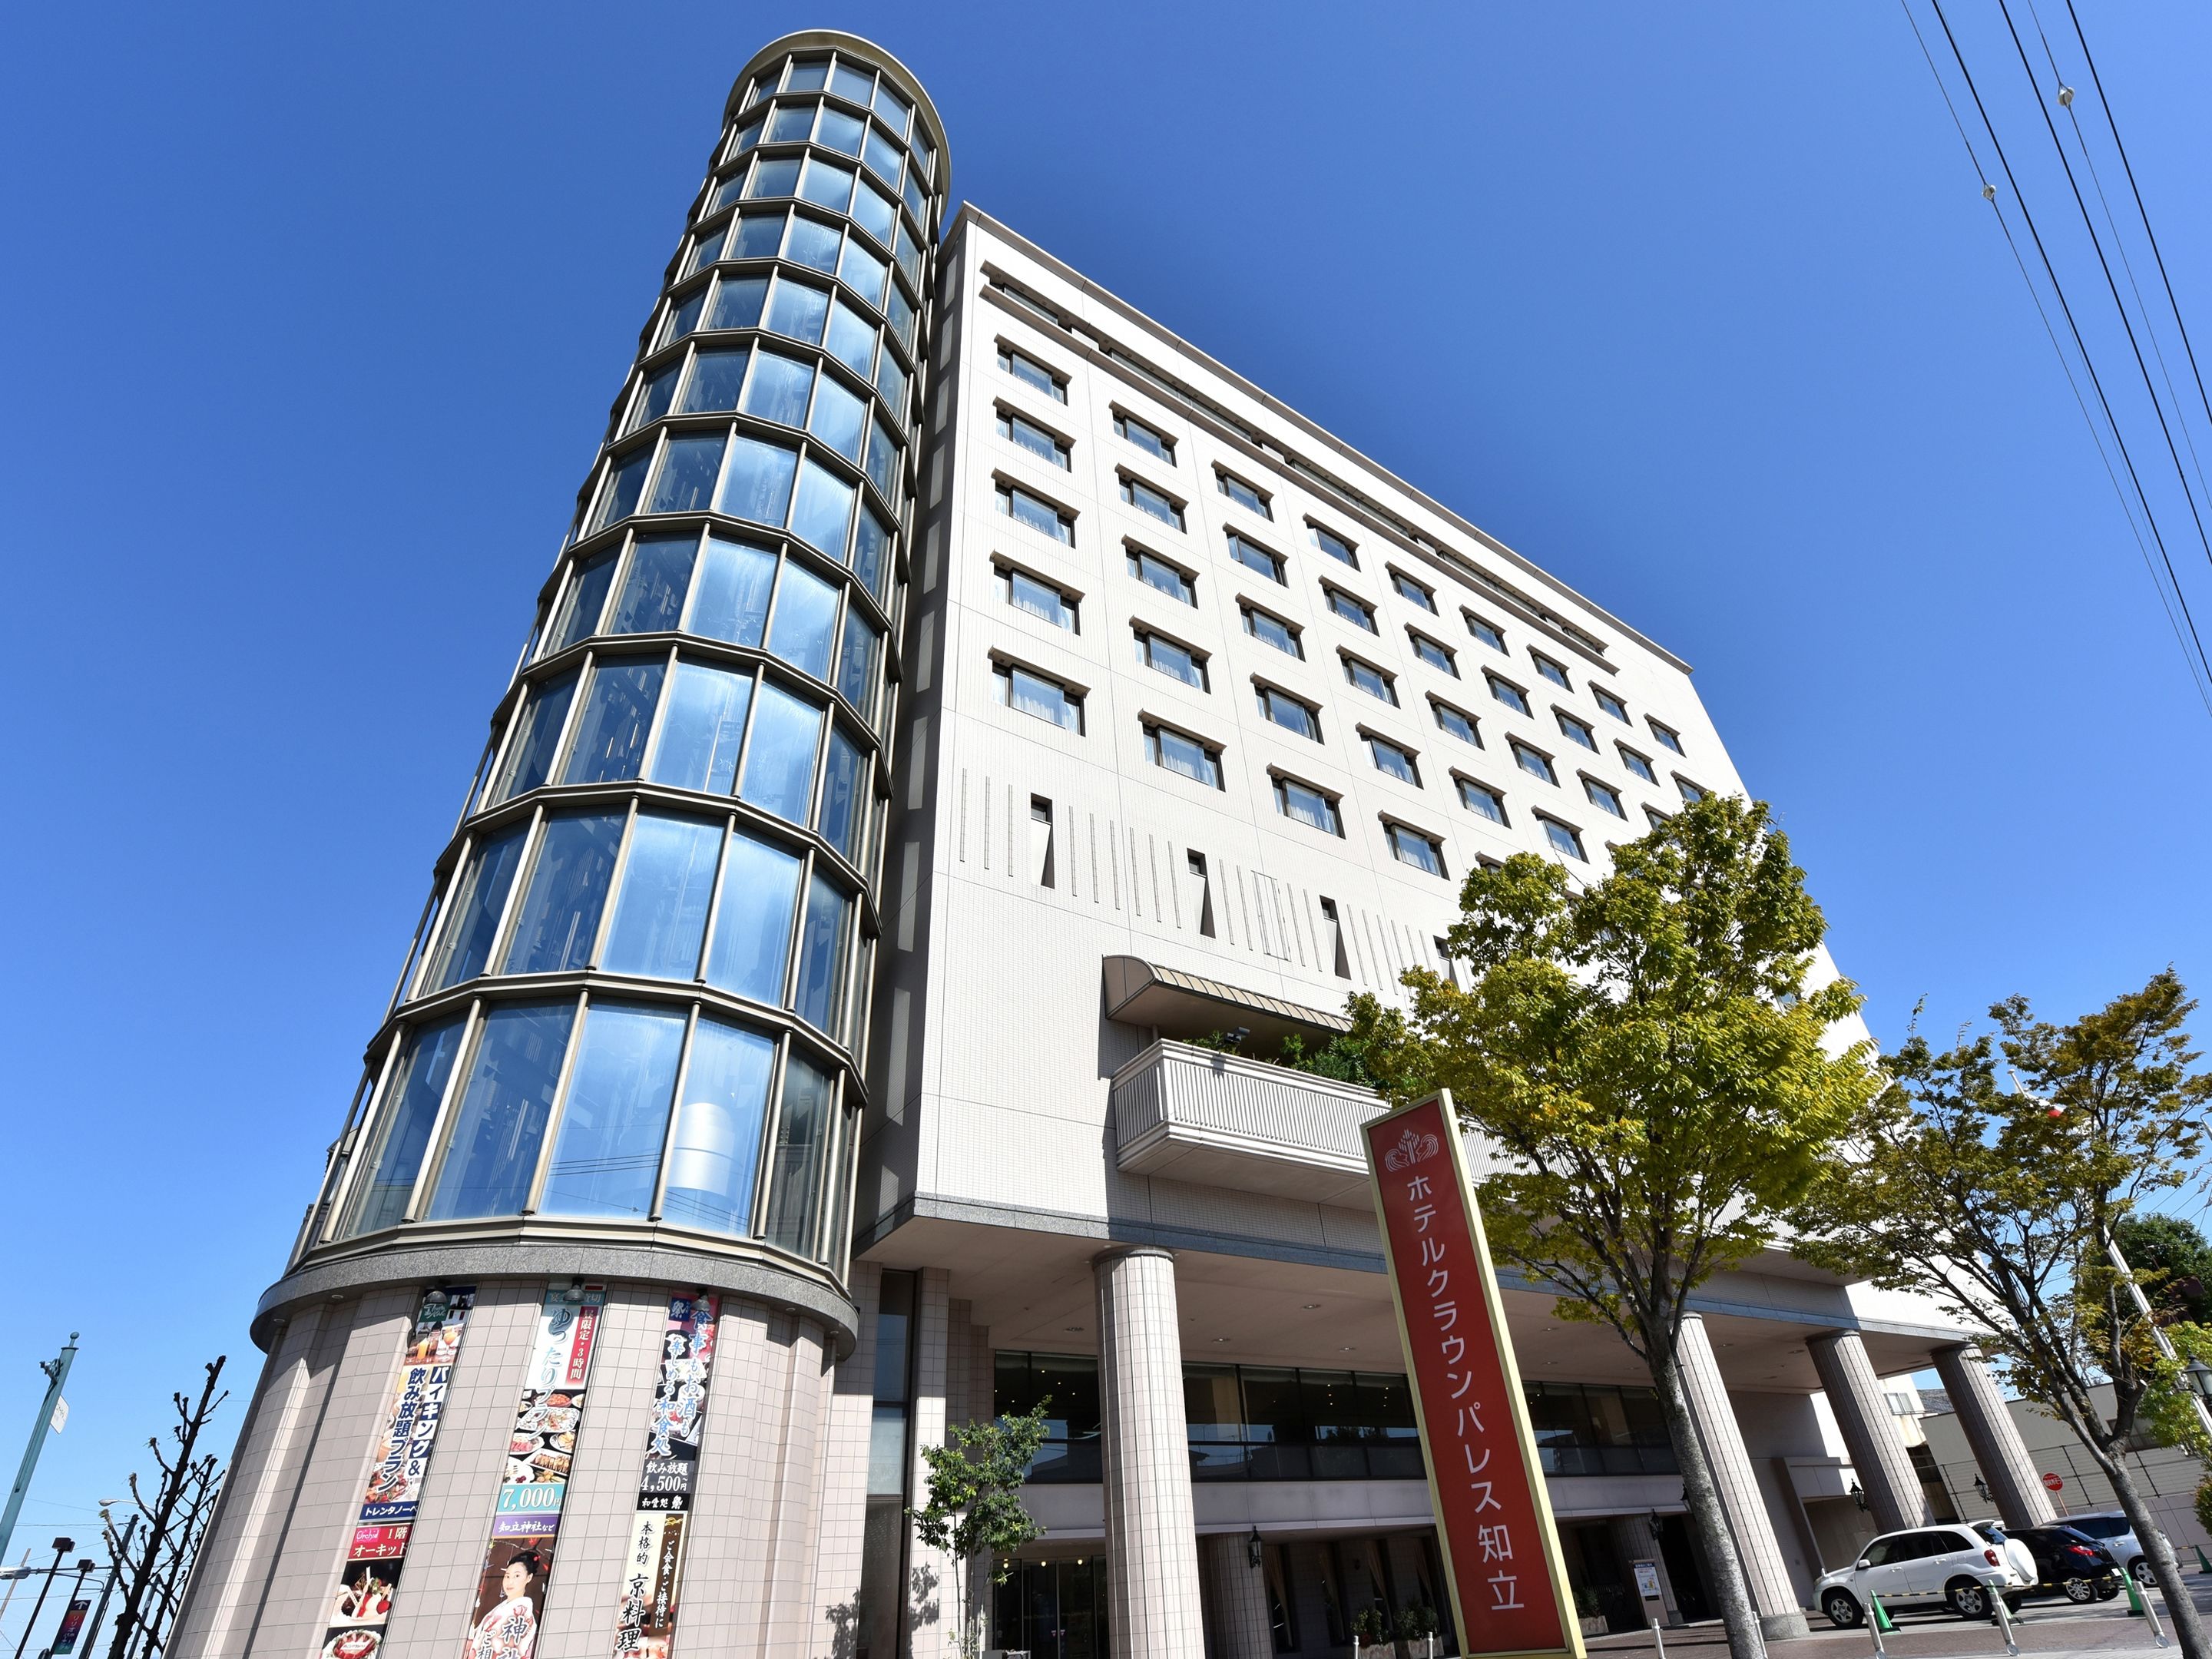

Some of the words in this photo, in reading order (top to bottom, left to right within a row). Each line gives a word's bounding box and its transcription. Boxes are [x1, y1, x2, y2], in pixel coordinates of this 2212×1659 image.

[528, 1308, 571, 1440] ゆったりプラン
[652, 1335, 685, 1455] 楽しめる和食処
[678, 1310, 712, 1436] 食事もお酒も
[1407, 1175, 1524, 1611] ホテルクラウンパレス知立
[377, 1367, 426, 1492] 飲み放題プラン
[646, 1461, 688, 1475] 飲み放題
[356, 1529, 379, 1540] Orchid
[387, 1526, 408, 1540] 1階
[498, 1521, 555, 1533] 知立神社など
[502, 1488, 562, 1511] 7,000円
[655, 1540, 675, 1628] ご会食・ご接待に
